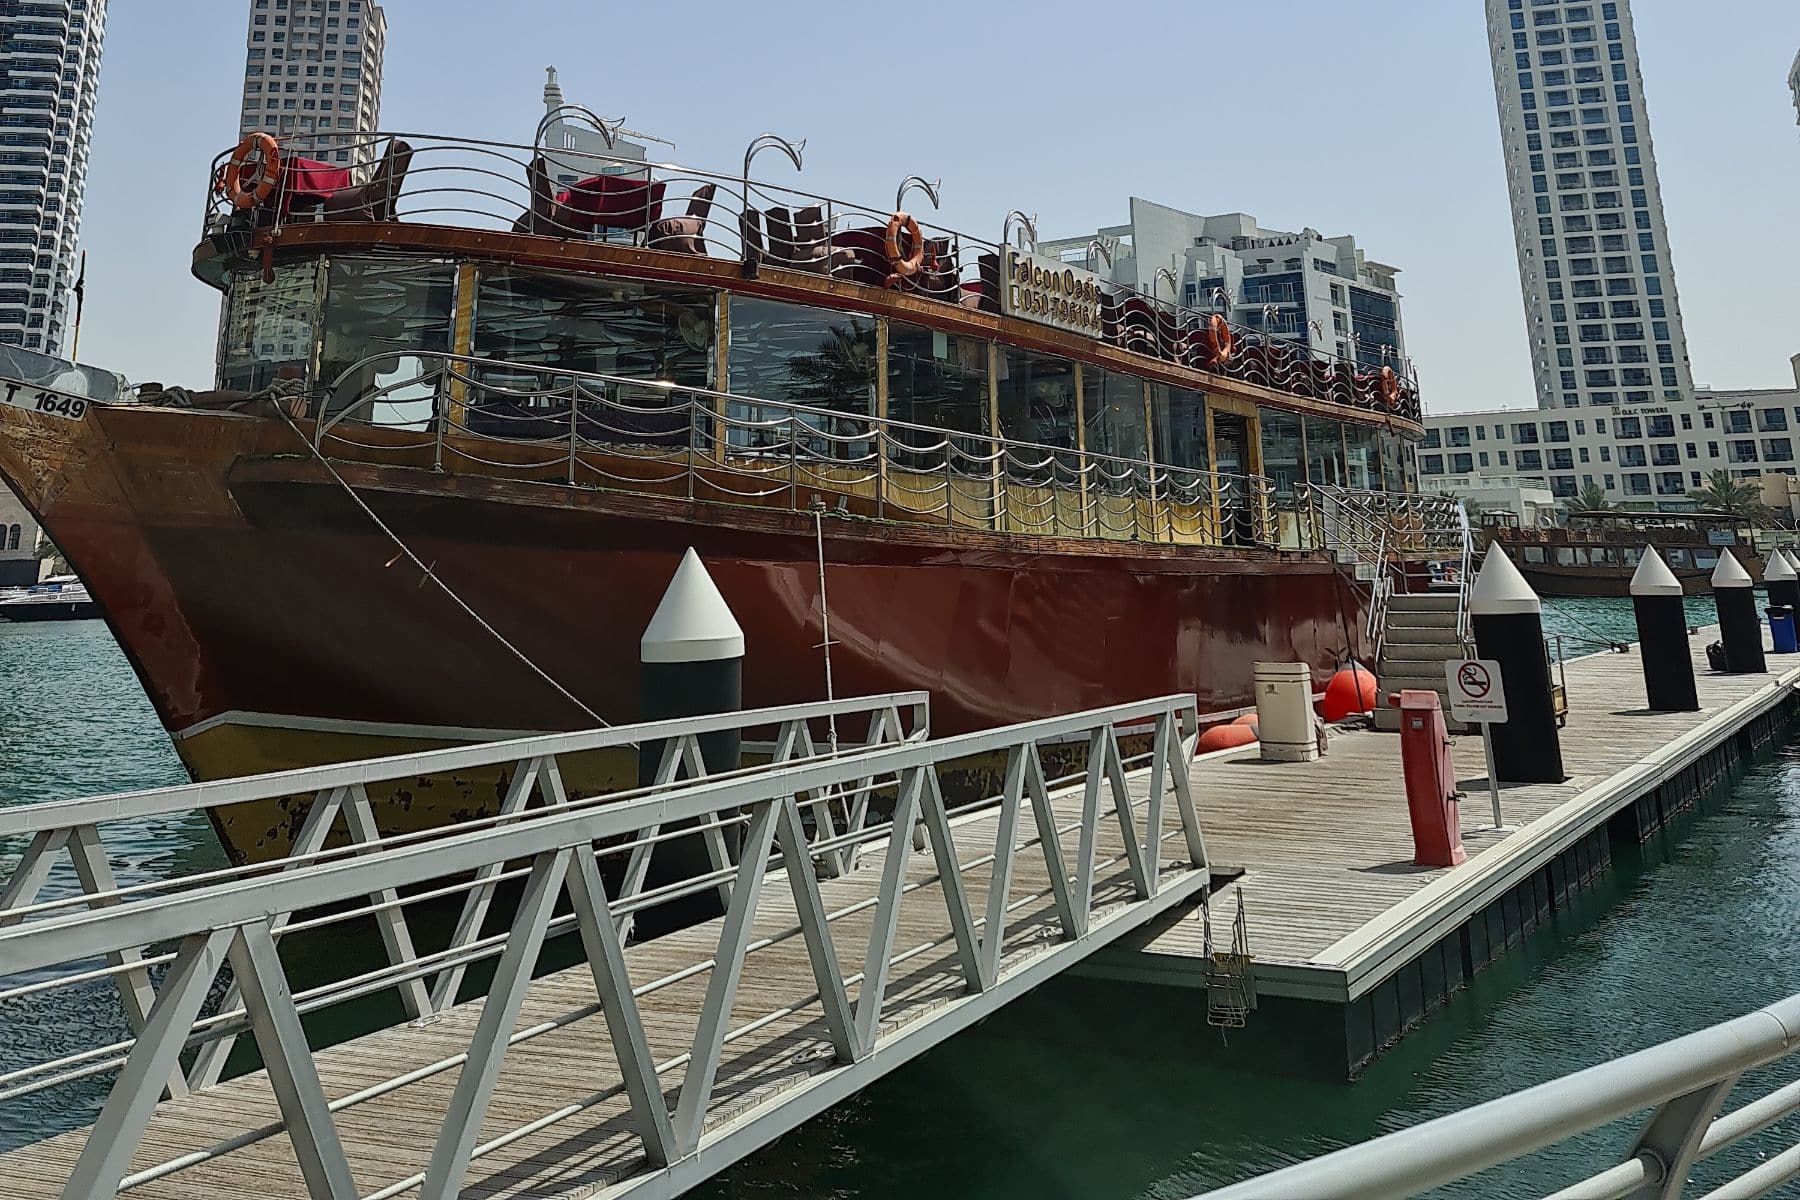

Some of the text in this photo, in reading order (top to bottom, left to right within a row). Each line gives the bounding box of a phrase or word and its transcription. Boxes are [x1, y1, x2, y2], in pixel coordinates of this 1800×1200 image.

[1008, 252, 1102, 304] Falcon Oasis
[5, 383, 85, 418] T 1649
